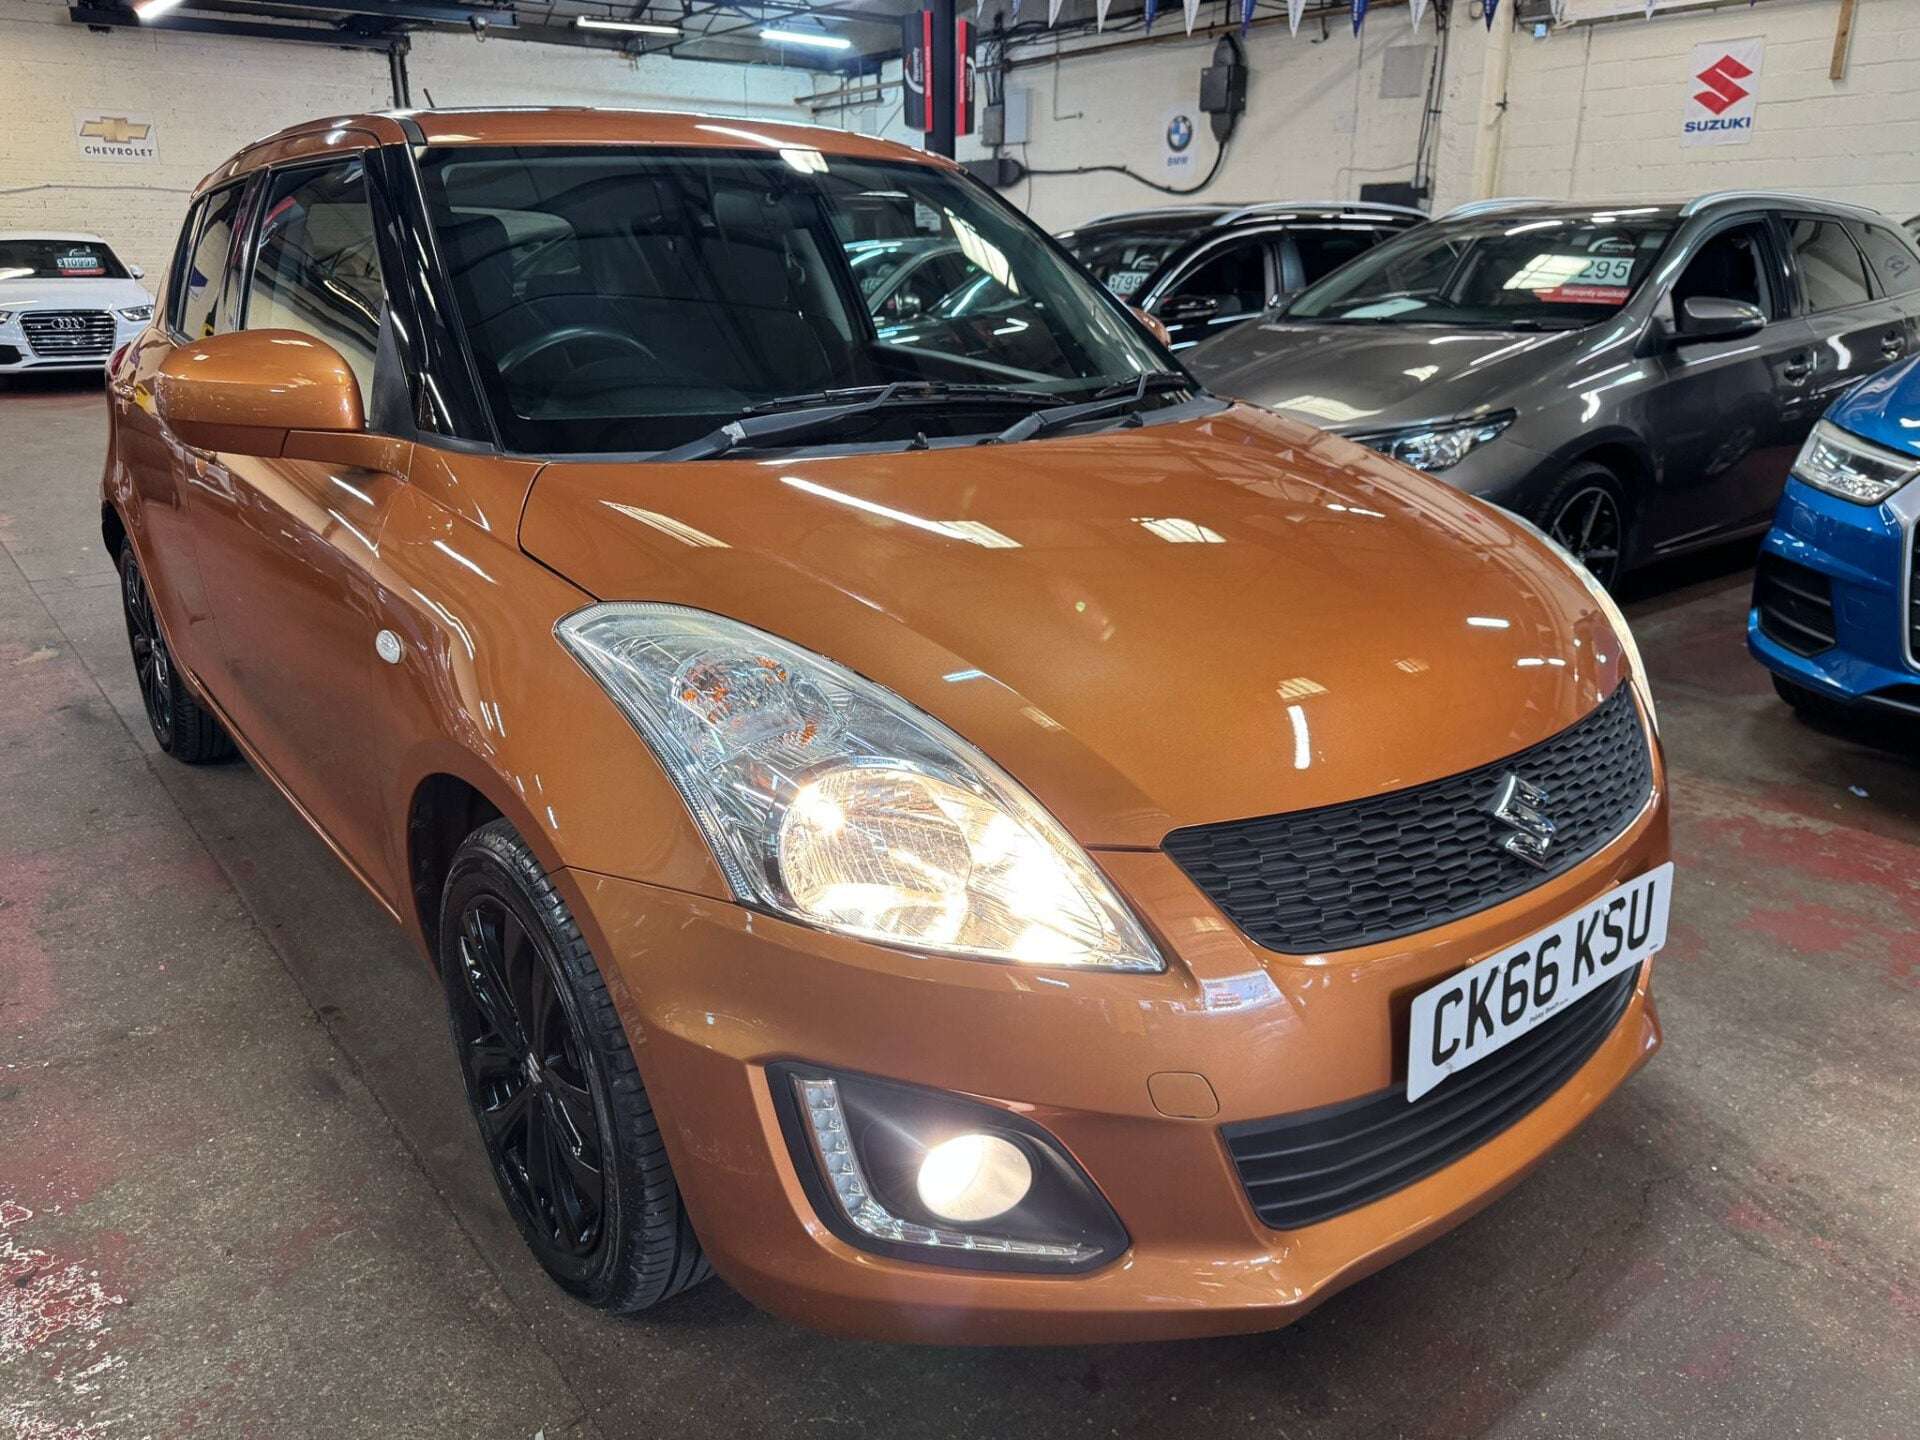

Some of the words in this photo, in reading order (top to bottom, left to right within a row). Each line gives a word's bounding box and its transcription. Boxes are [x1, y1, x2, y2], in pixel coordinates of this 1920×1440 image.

[1683, 116, 1752, 133] SUZUKI
[84, 145, 153, 157] CHEVROLET
[1432, 934, 1561, 1066] CK66
[1572, 880, 1655, 987] KSU
